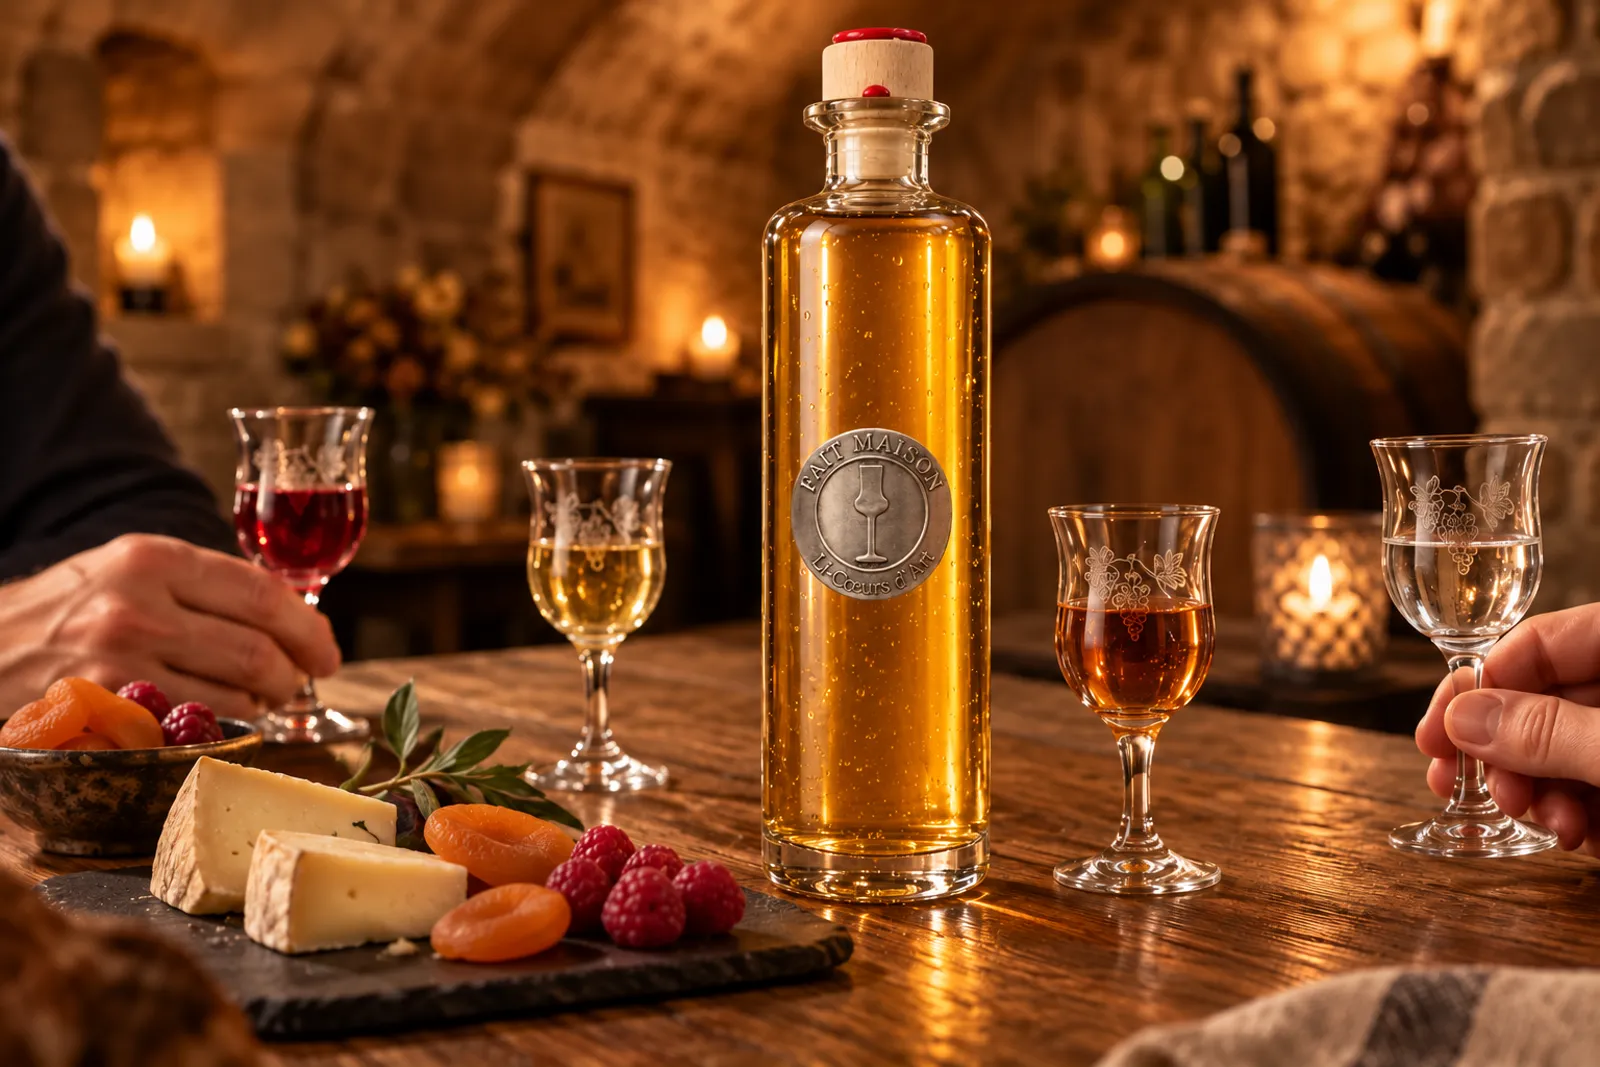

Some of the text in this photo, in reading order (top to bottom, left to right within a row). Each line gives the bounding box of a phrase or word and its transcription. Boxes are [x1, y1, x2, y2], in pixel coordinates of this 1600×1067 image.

[800, 433, 944, 493] FAIT MAISON
[811, 552, 891, 595] Li-Cœurs
